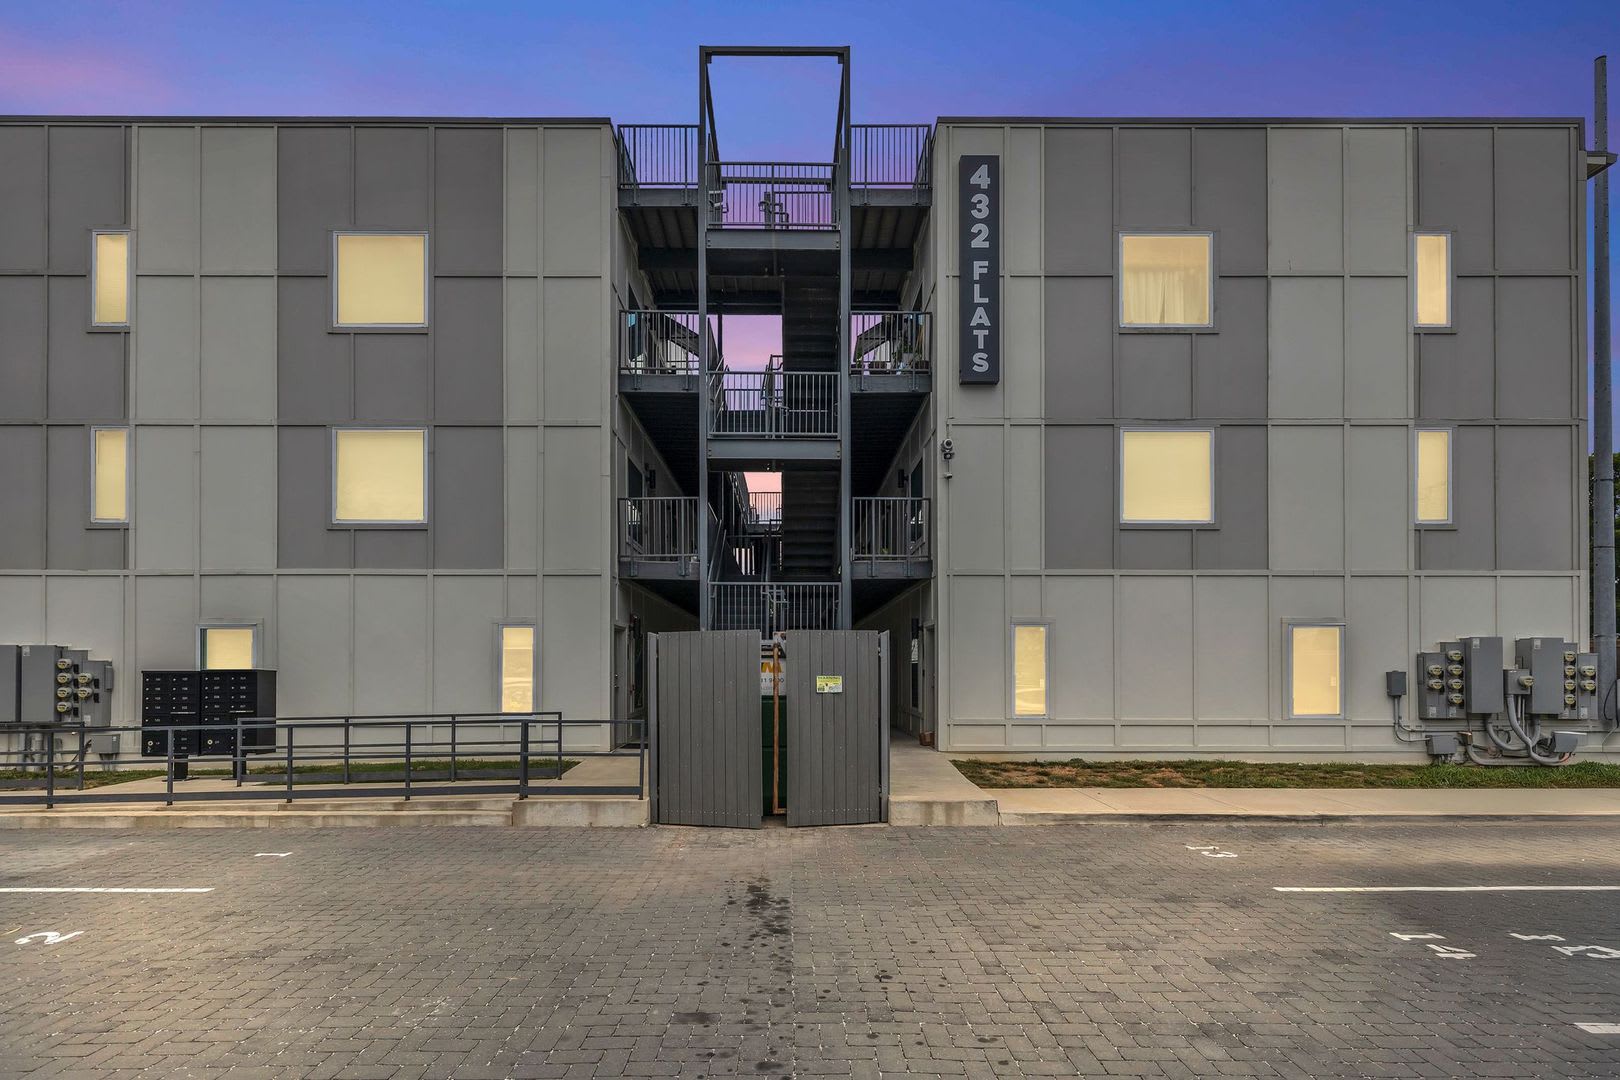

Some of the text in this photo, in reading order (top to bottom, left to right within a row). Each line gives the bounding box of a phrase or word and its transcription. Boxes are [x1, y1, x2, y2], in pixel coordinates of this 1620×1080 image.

[970, 164, 991, 373] 432 FLATS
[14, 930, 85, 945] 2
[1389, 932, 1478, 960] 14
